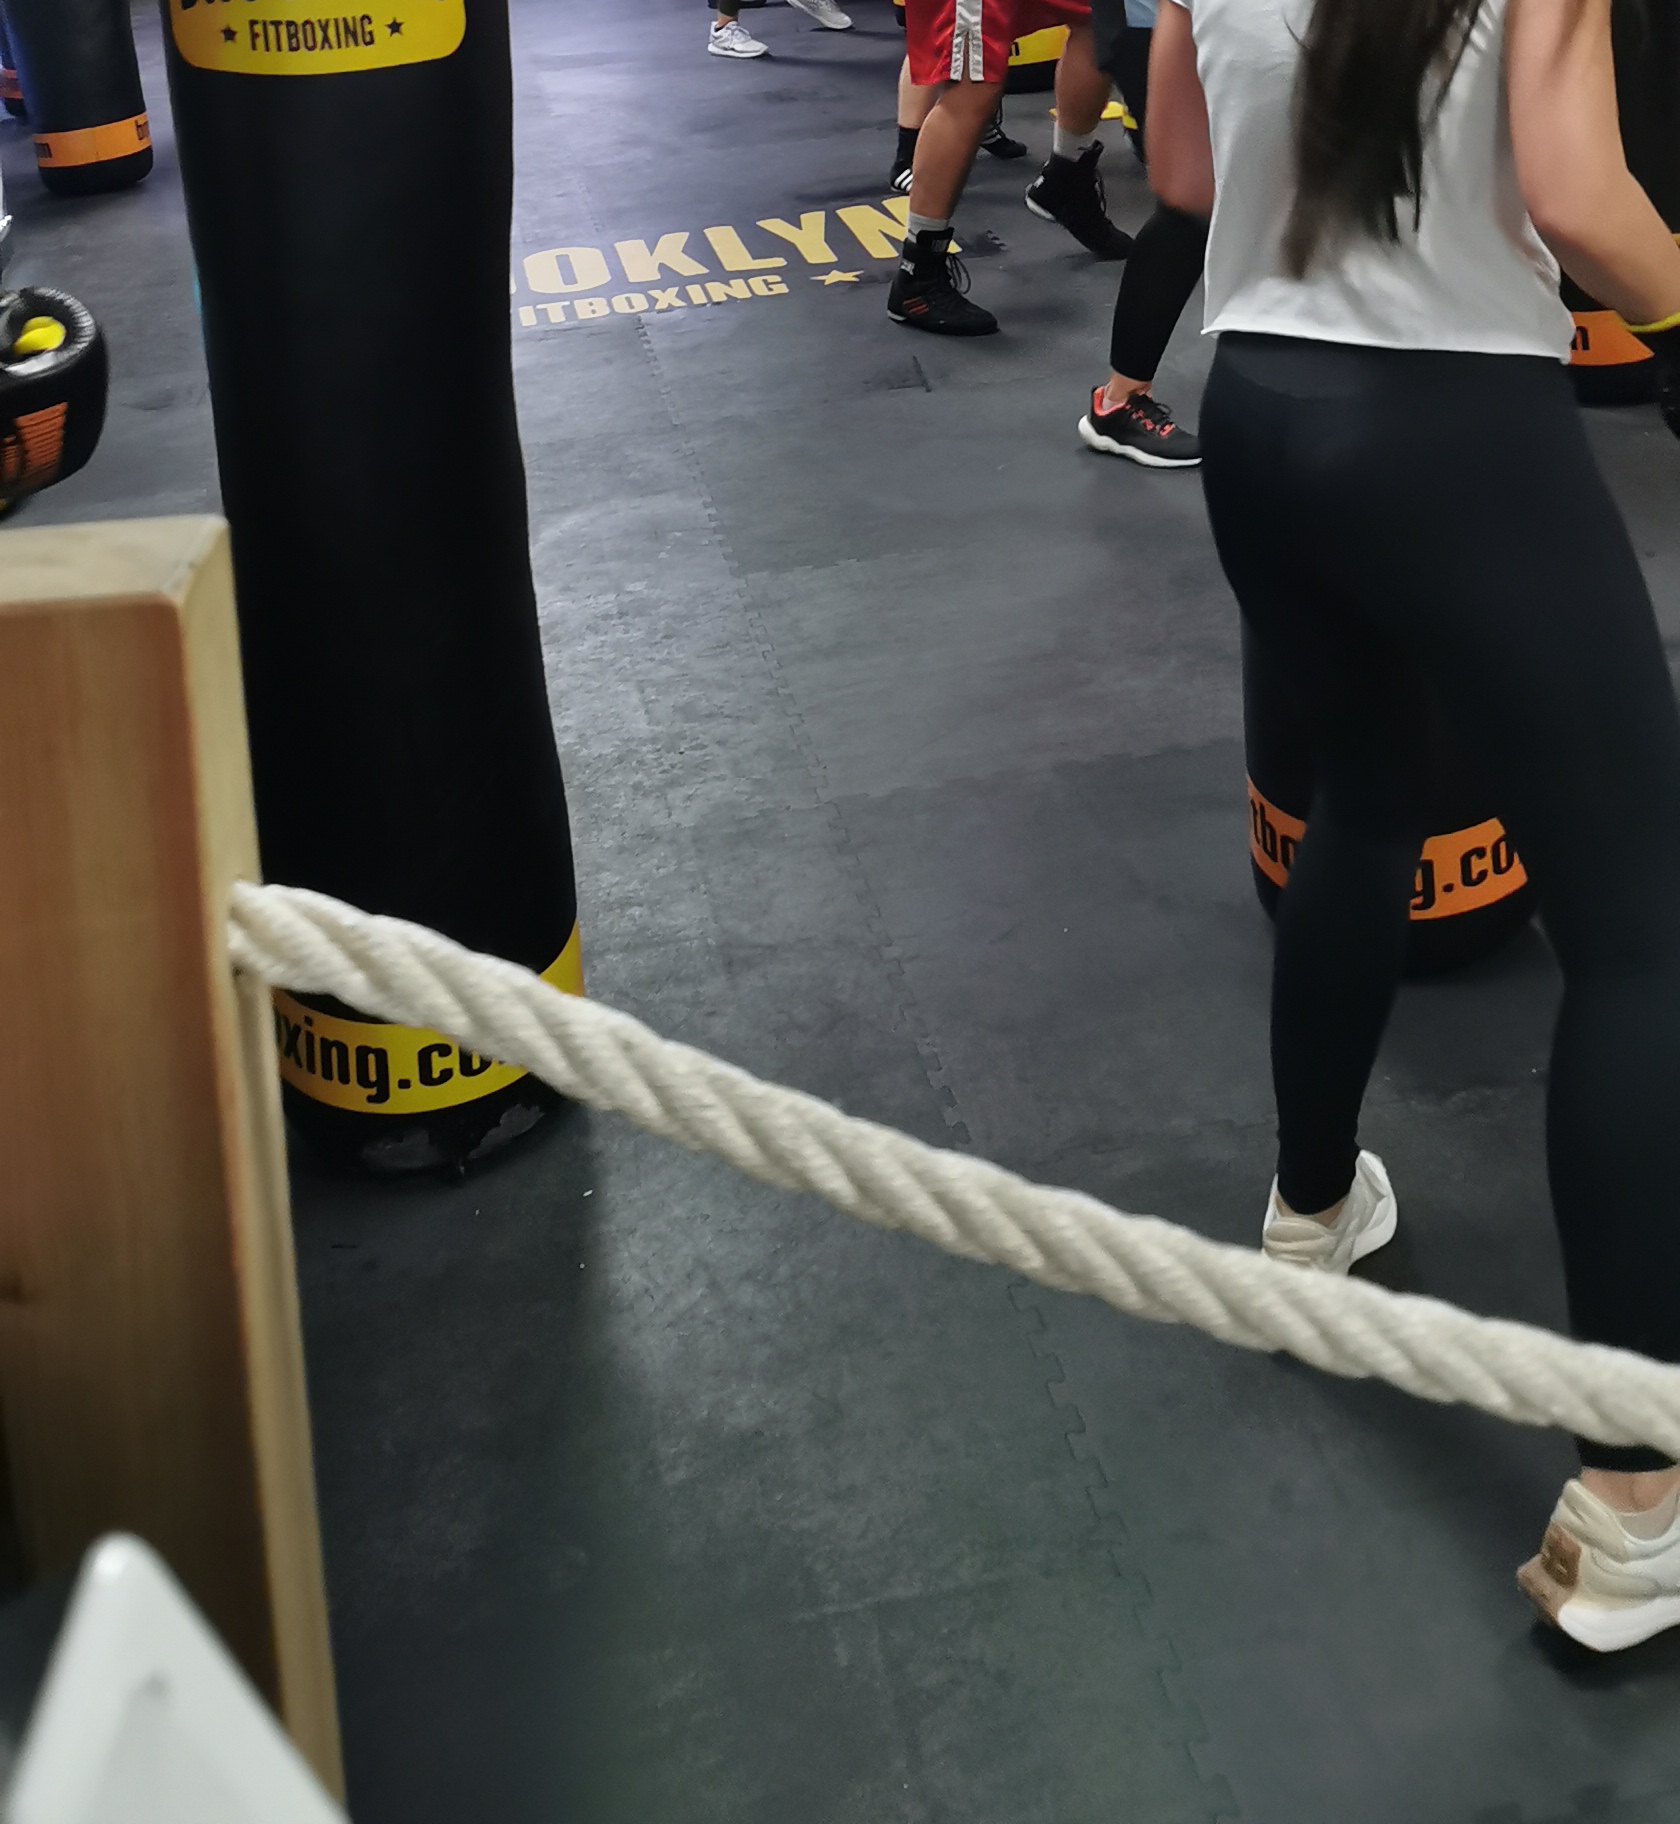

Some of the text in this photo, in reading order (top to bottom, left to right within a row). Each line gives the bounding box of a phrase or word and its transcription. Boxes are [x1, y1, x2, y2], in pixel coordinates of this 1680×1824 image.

[248, 14, 375, 53] FITBOXING
[511, 195, 963, 295] OKLYN
[518, 274, 790, 327] ITBOXING
